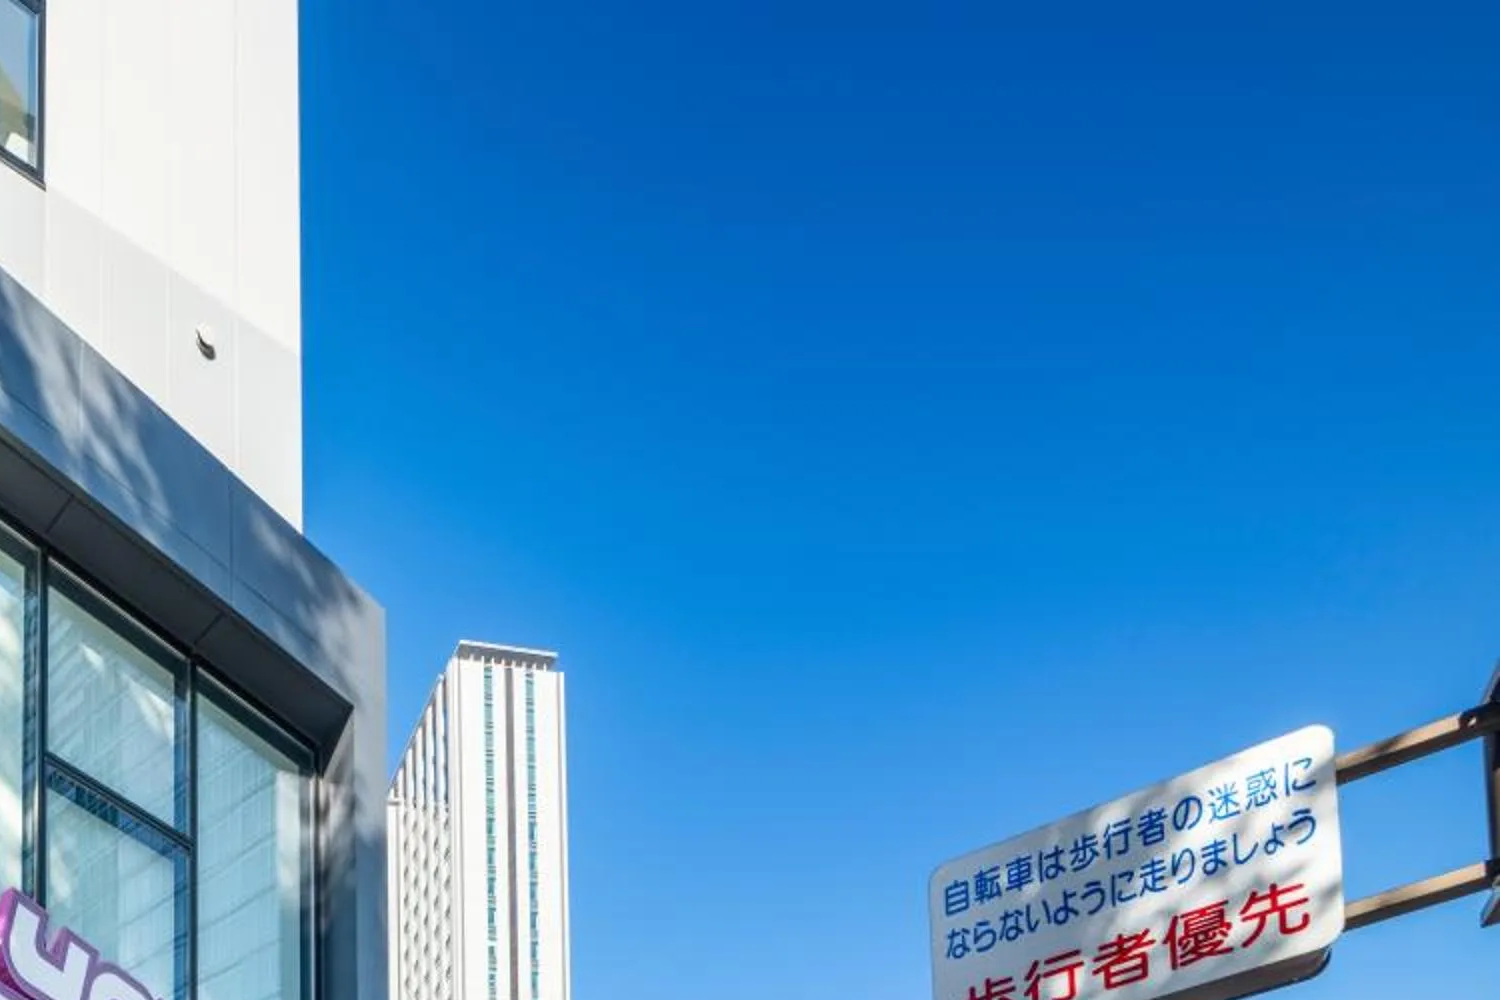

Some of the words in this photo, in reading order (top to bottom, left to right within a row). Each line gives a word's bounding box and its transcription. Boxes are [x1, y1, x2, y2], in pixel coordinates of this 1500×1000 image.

[943, 757, 1318, 917] 自転車は歩行者の迷惑に
[945, 807, 1318, 960] ならないように走りましょう
